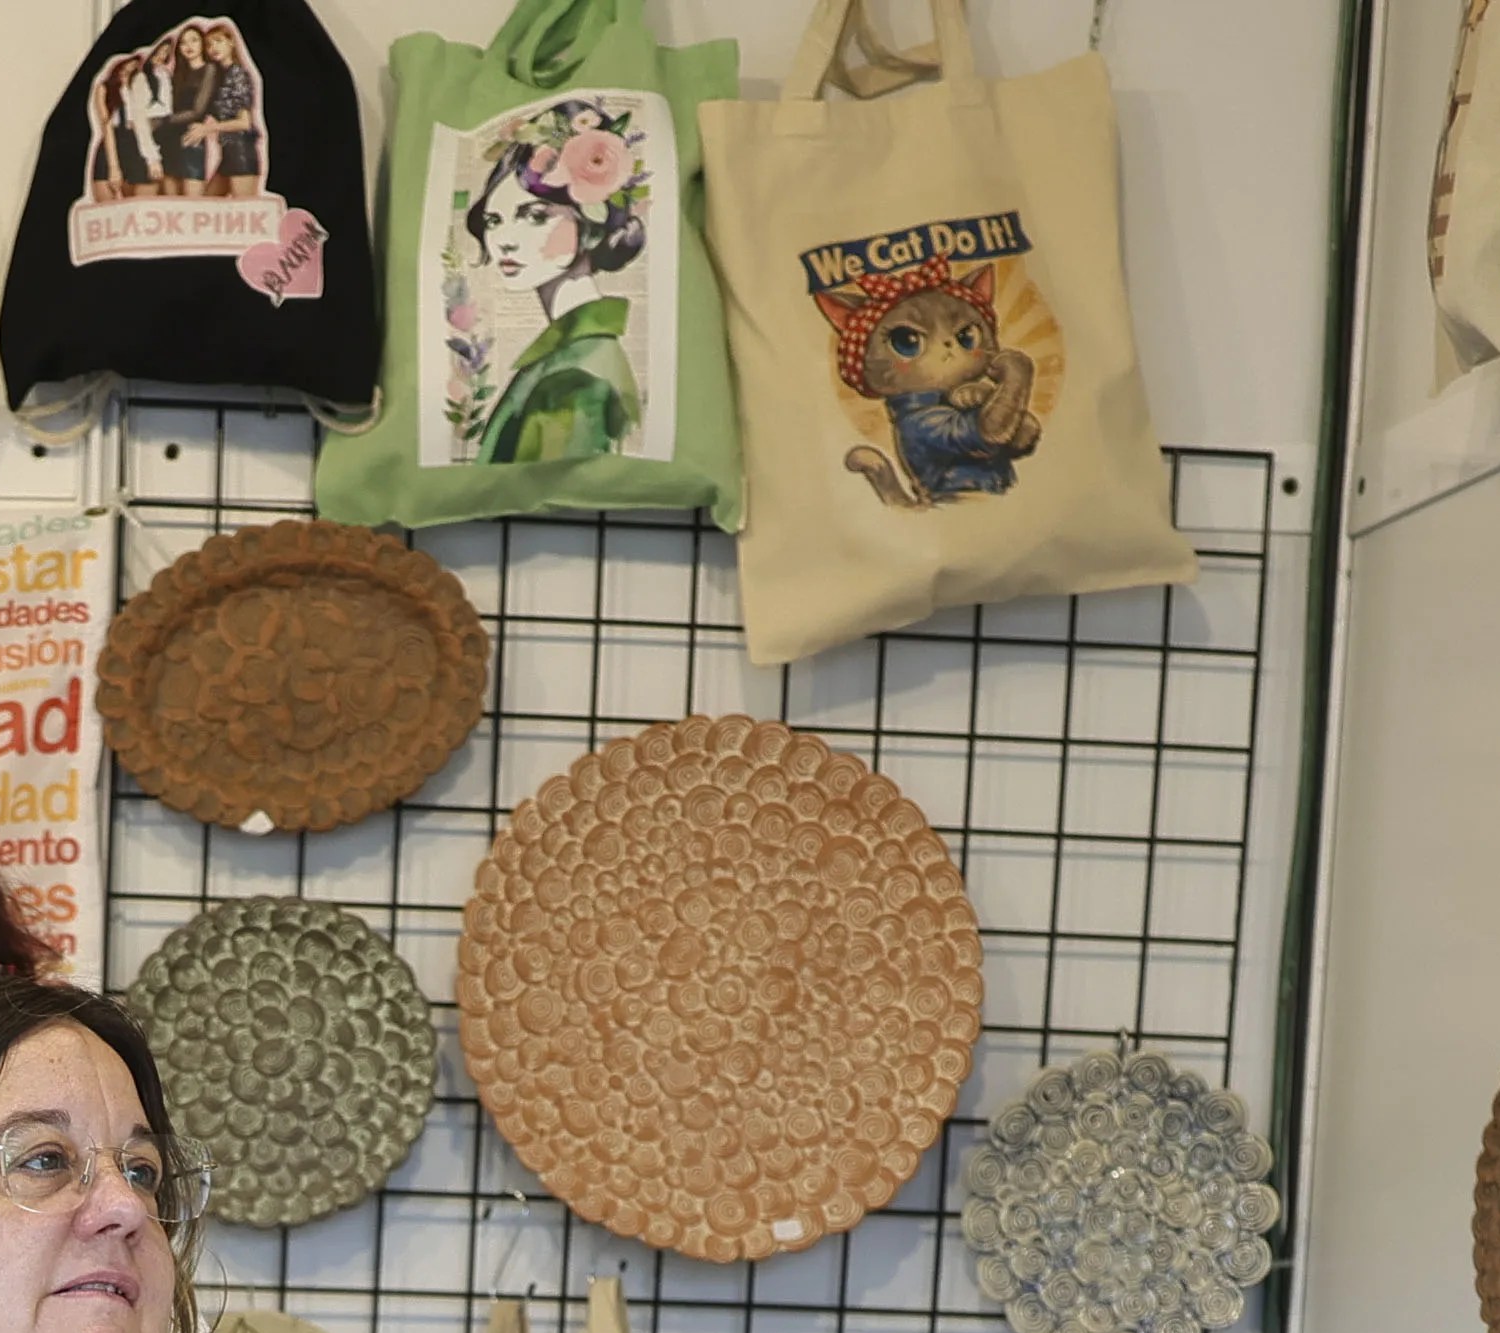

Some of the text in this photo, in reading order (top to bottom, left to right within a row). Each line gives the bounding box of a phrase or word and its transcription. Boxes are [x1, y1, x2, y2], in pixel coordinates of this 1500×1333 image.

[192, 210, 268, 236] PINK
[808, 216, 1018, 287] We Cat Do It!
